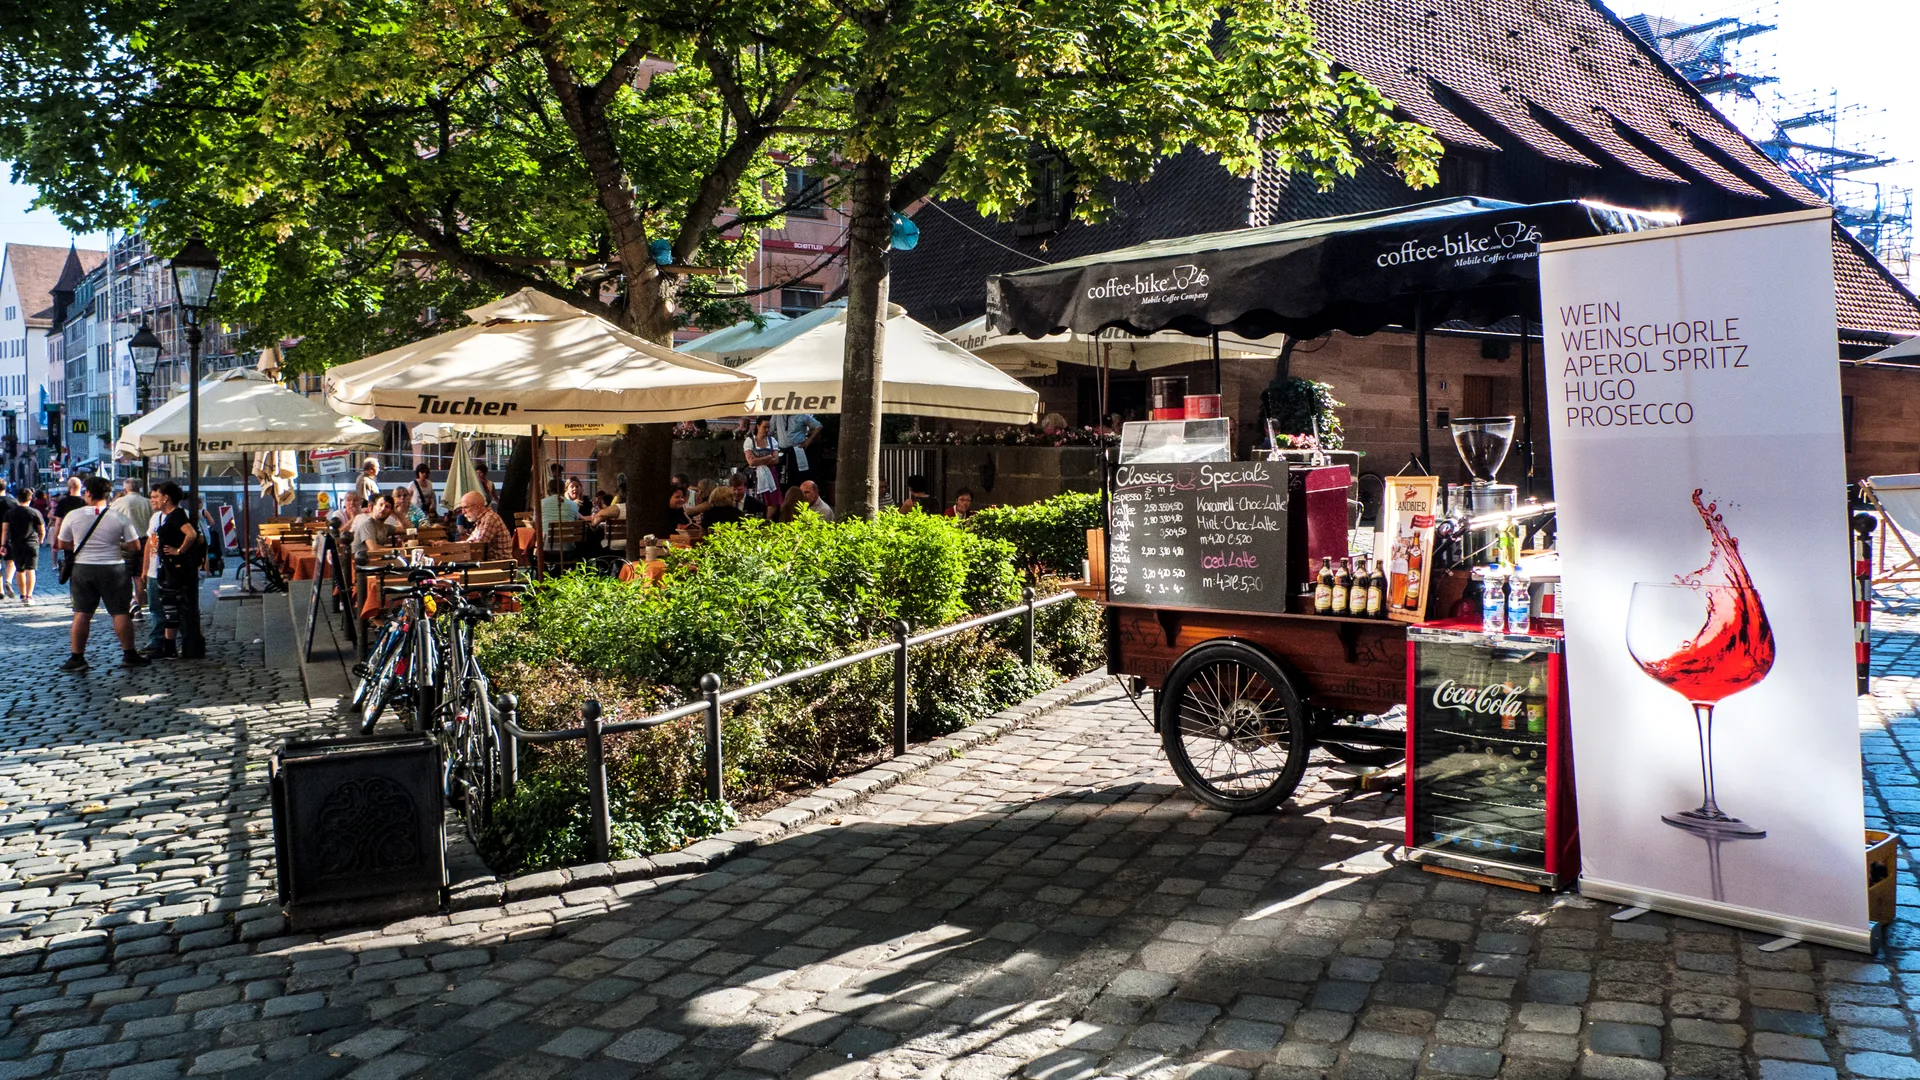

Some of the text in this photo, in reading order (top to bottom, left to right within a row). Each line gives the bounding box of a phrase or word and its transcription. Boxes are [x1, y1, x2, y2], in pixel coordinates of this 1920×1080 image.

[1454, 251, 1539, 267] Mobile Coffee Compan
[1141, 292, 1209, 305] Mobile Coffee Company
[1560, 301, 1620, 327] WEIN
[1561, 317, 1740, 352] WEINSCHORLE
[1563, 344, 1749, 377] APEROL SPRITZ
[1564, 378, 1636, 402] HUGO
[417, 394, 518, 416] Tucher
[762, 391, 837, 411] ucher
[1566, 402, 1694, 427] PROSECCO
[1116, 466, 1174, 487] Classics
[1200, 462, 1270, 493] Specials
[1112, 492, 1142, 505] Espresso
[1112, 504, 1137, 517] Kaffee
[1111, 518, 1135, 530] Cappu
[1110, 563, 1128, 574] Chai
[1201, 550, 1259, 569] Iced Latte
[1110, 583, 1126, 595] Tee
[1432, 679, 1528, 717] Coca-Cola
